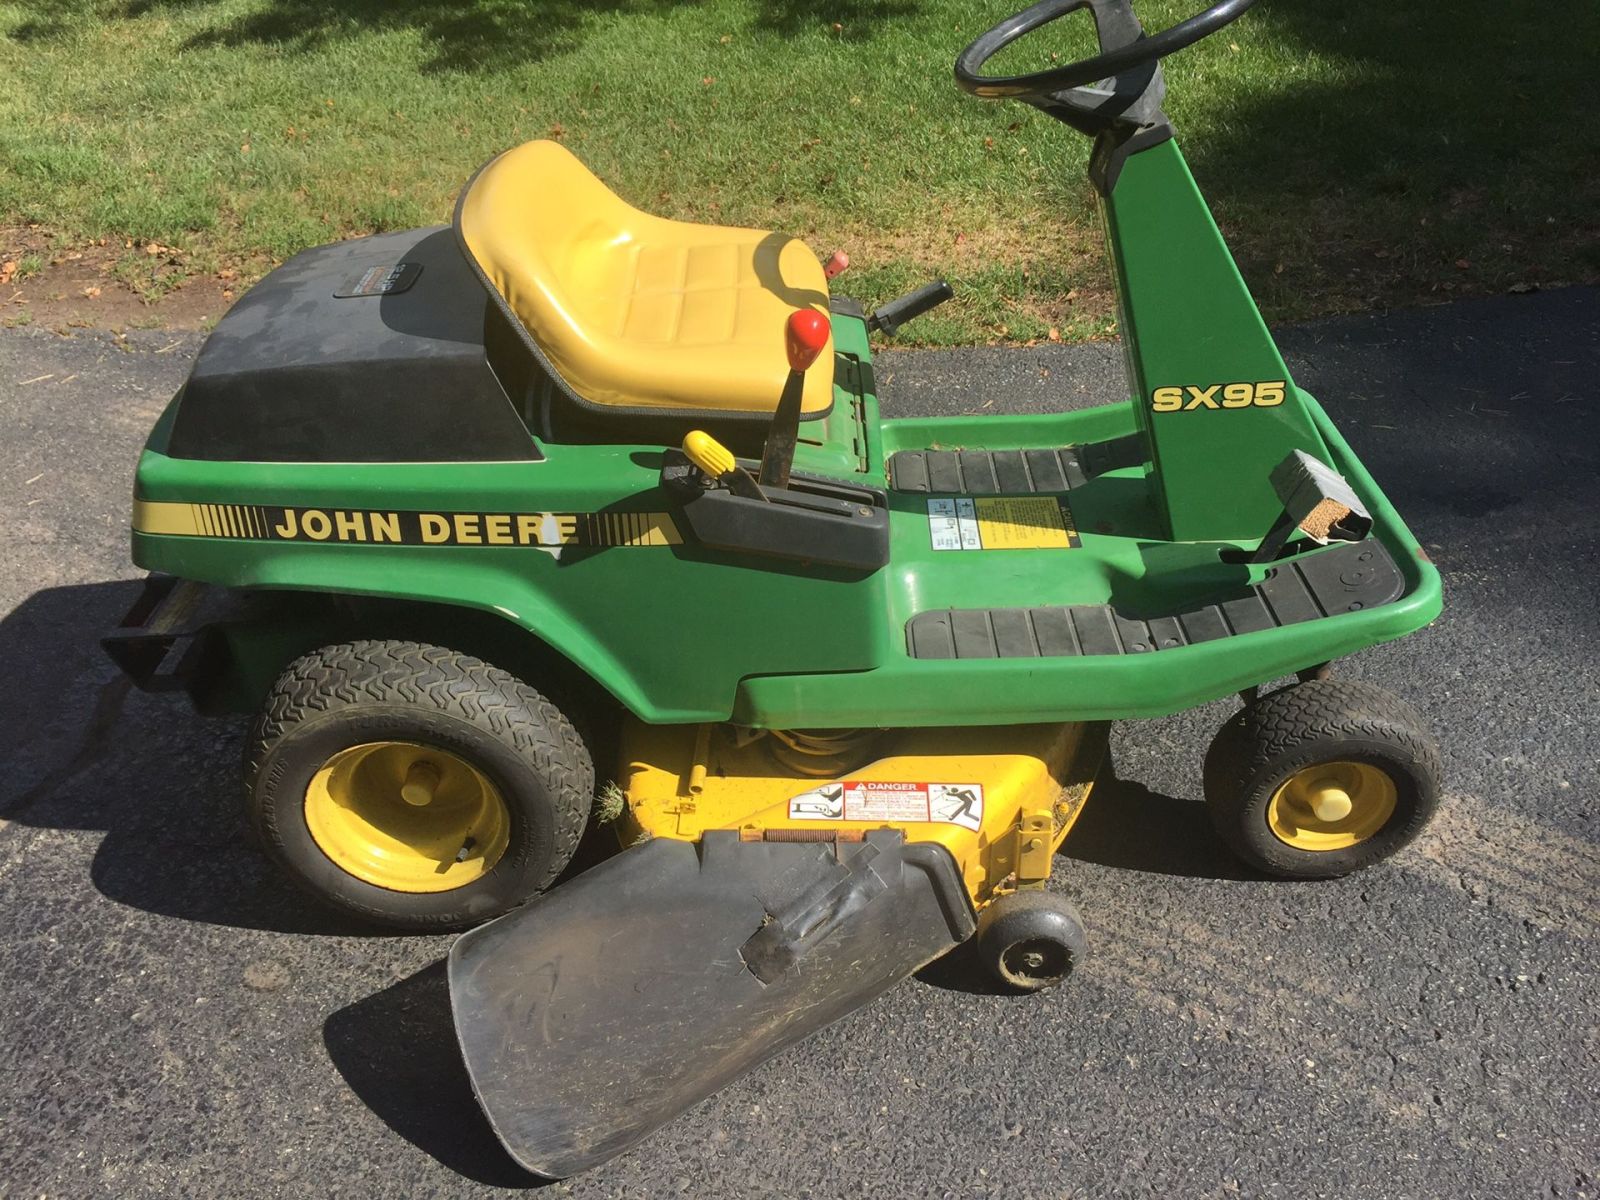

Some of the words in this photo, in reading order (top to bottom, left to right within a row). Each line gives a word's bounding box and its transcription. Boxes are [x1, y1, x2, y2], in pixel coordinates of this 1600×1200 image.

[1152, 380, 1287, 413] SX95
[275, 509, 402, 543] JOHN
[421, 514, 579, 545] DEERE
